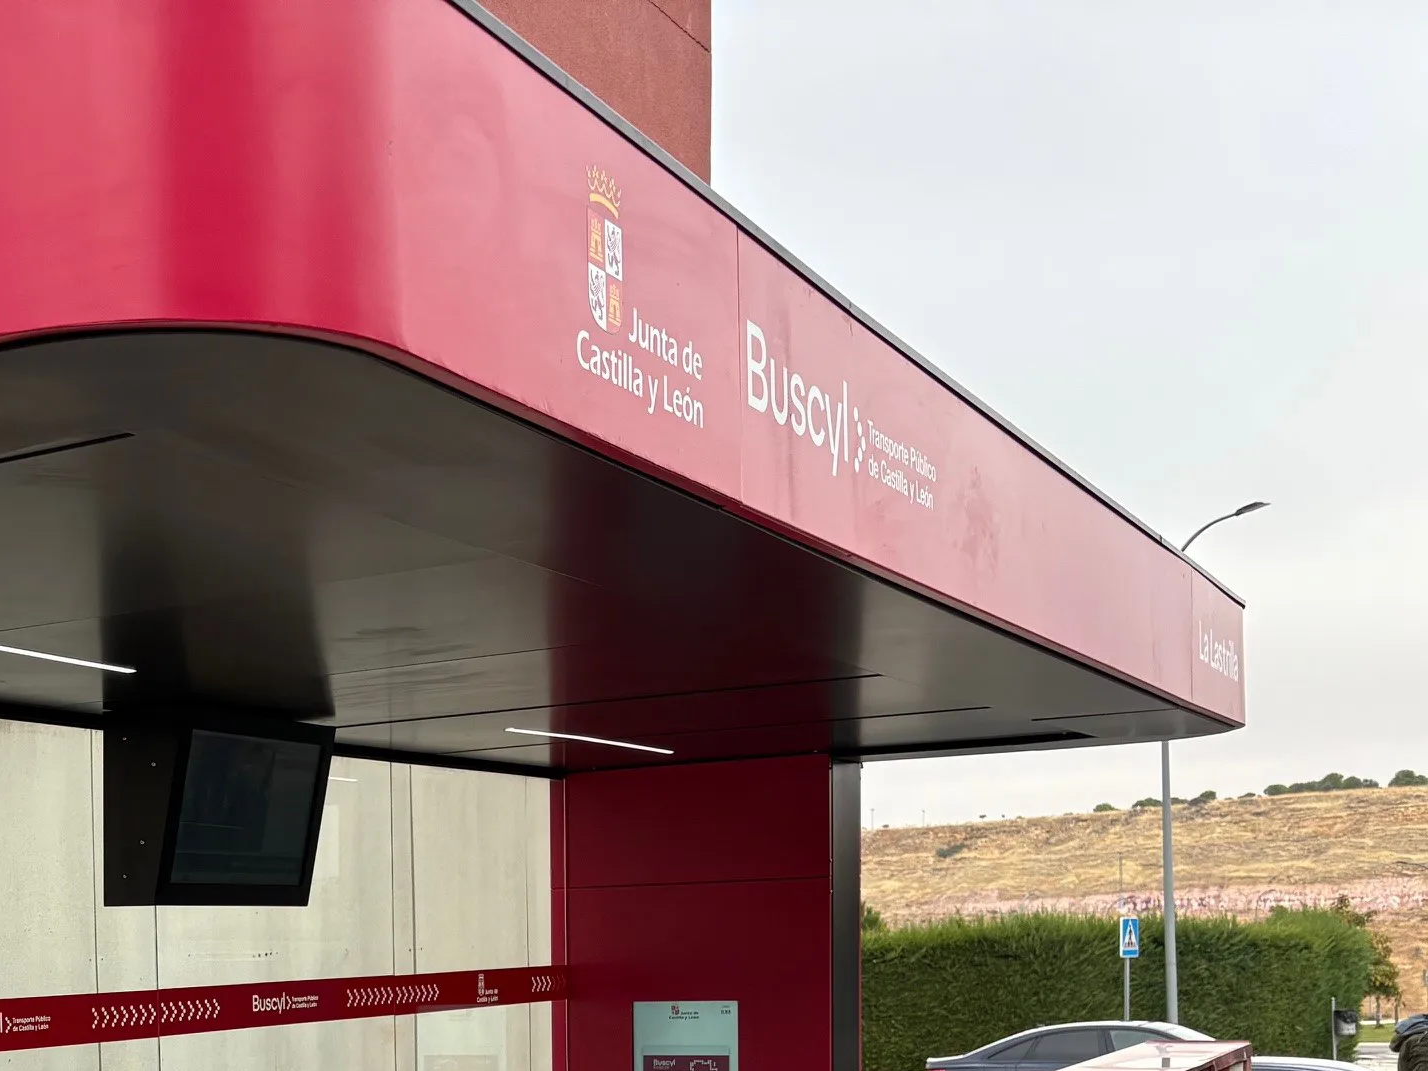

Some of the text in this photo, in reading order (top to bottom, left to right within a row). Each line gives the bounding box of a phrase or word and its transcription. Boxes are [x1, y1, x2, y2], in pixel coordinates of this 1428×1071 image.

[628, 307, 703, 380] Junta de
[576, 329, 704, 429] Castilla y León
[746, 319, 849, 476] Buscyl
[867, 419, 937, 483] Transporte Público
[868, 454, 934, 511] de Castilla y León
[1198, 619, 1209, 663] La
[252, 992, 285, 1014] Buscyl
